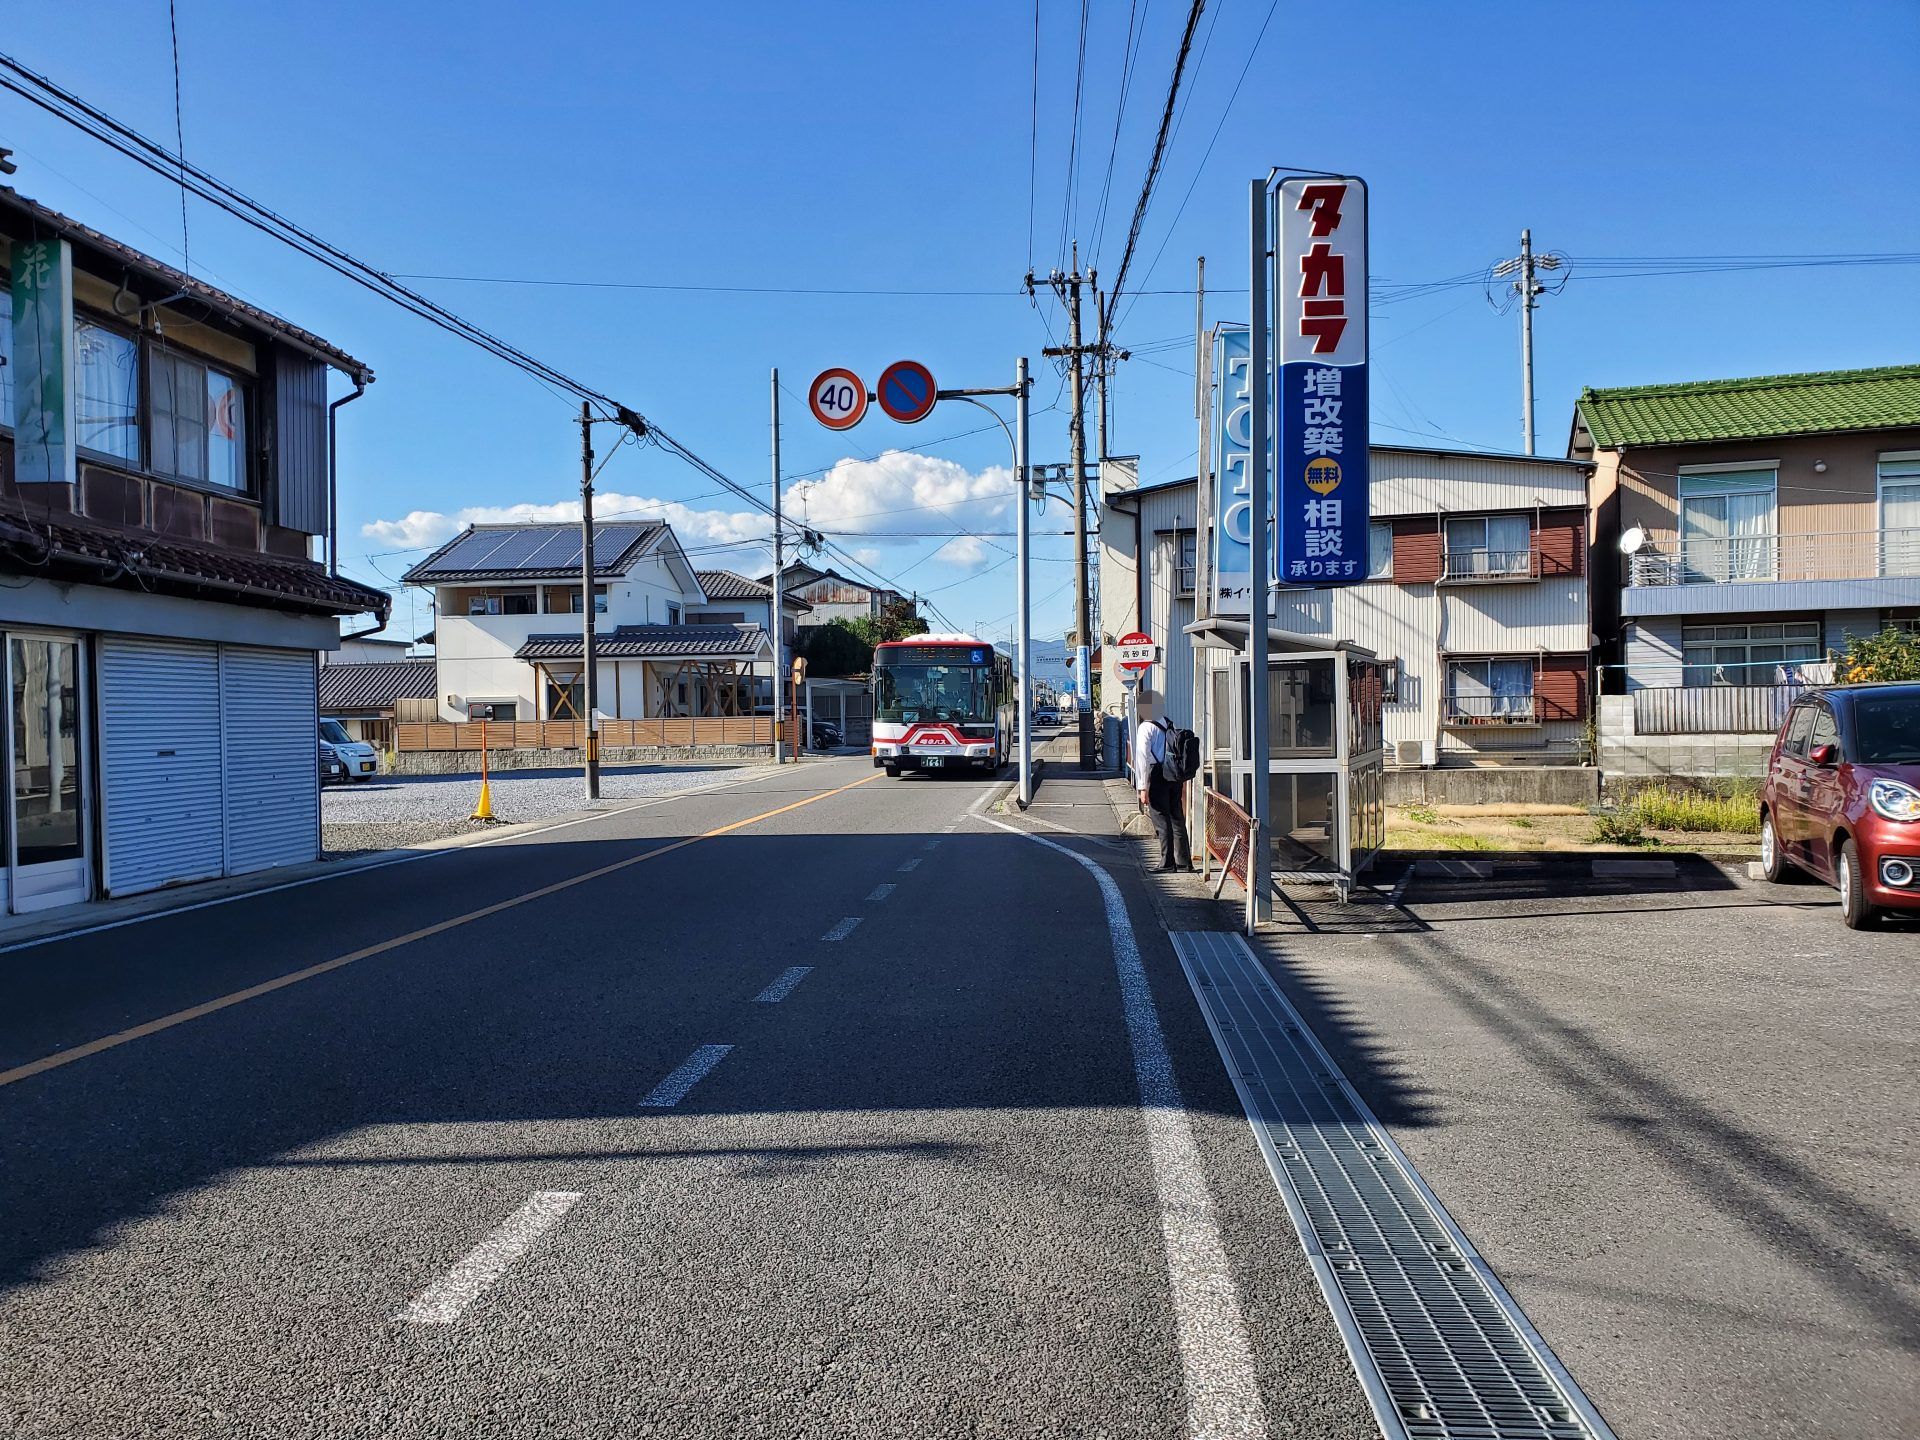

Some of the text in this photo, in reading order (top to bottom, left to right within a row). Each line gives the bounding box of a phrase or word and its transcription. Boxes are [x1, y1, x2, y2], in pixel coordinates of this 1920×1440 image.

[1296, 184, 1348, 354] タカラ
[819, 384, 854, 412] 40
[1303, 368, 1343, 456] 増改築
[1307, 466, 1340, 485] 無料
[1303, 499, 1343, 558] 相談
[1290, 559, 1358, 577] 承ります
